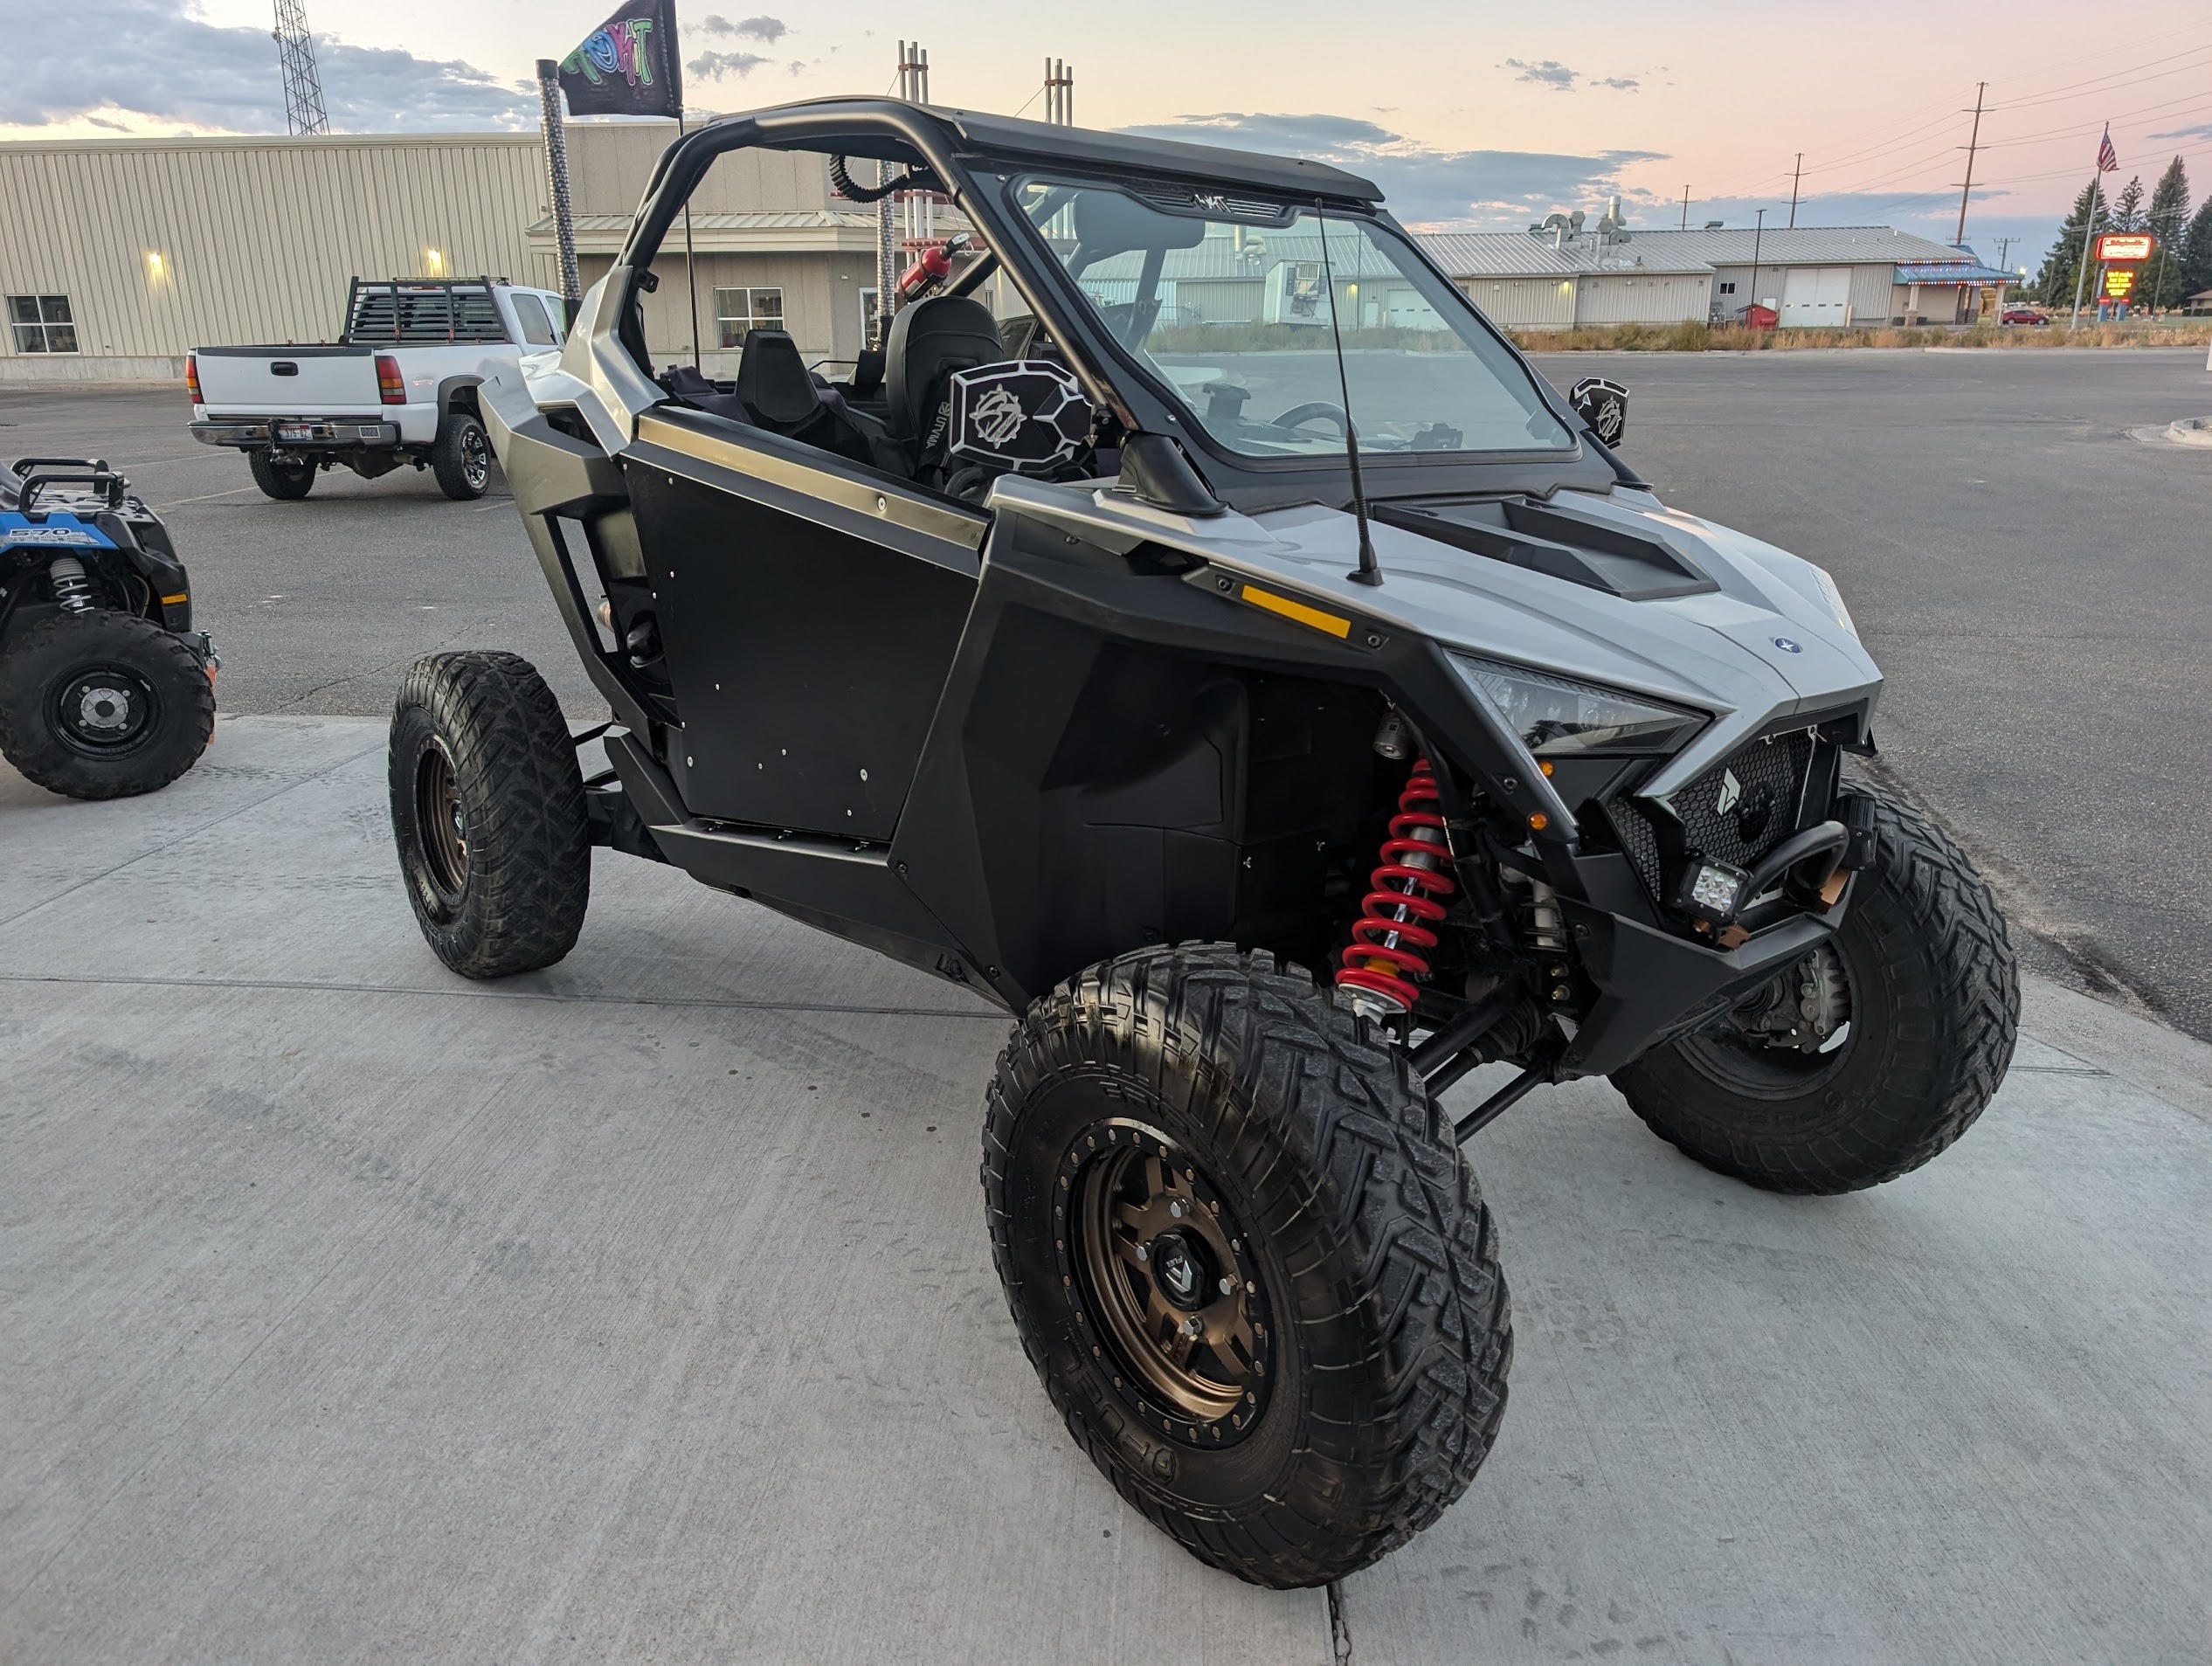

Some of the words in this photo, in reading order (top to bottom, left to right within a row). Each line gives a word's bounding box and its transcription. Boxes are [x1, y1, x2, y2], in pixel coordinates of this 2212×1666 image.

[926, 416, 947, 449] UTVMA
[10, 528, 71, 536] 570
[1166, 1255, 1183, 1268] FUEL
